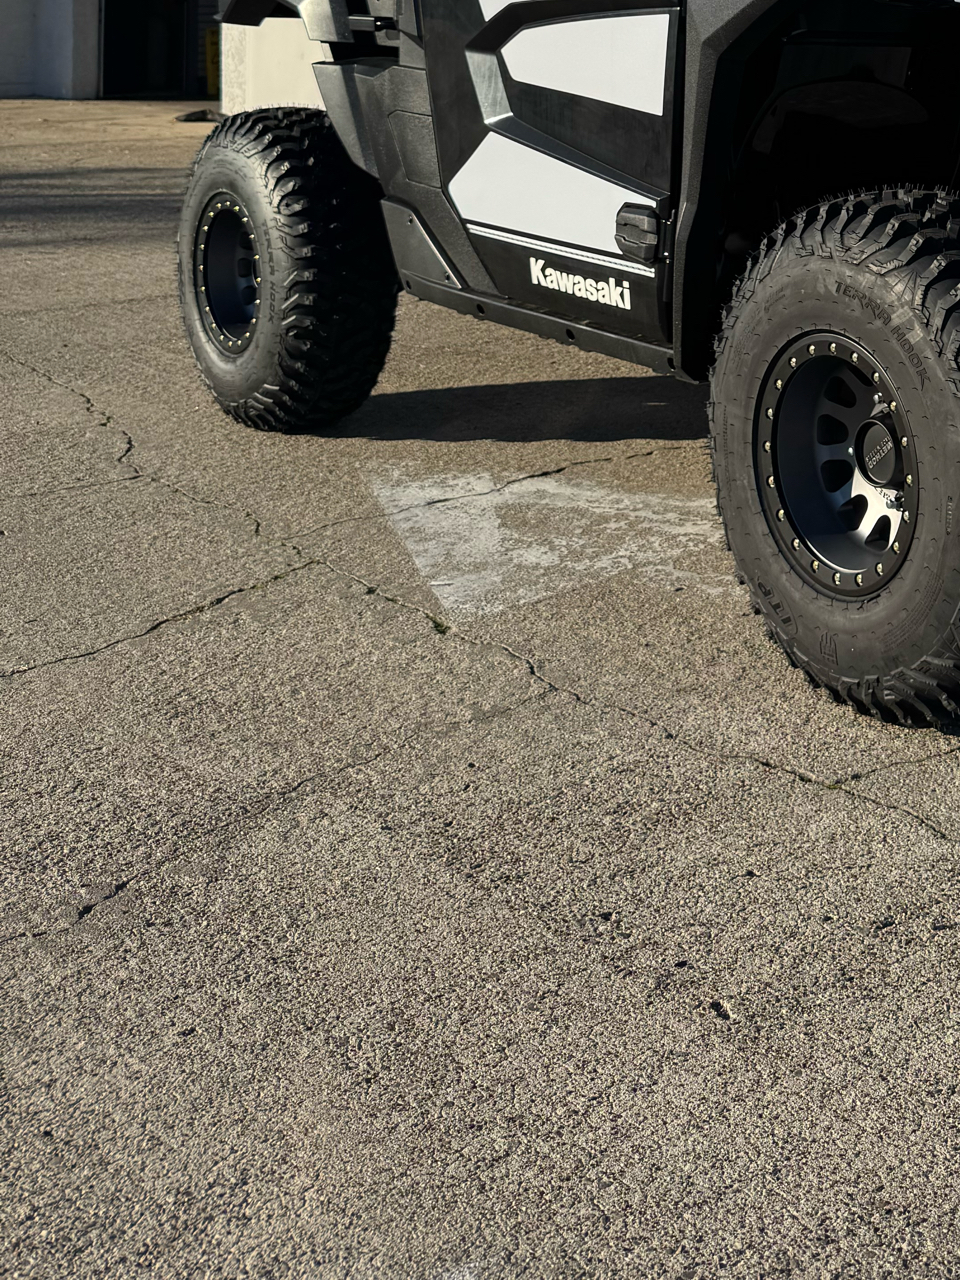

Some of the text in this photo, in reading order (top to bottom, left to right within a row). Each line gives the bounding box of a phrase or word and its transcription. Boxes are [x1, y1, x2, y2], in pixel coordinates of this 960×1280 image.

[529, 256, 631, 311] Kawasaki
[834, 280, 932, 392] TERRA HOOK
[868, 440, 893, 470] METHOD
[757, 580, 793, 628] ITP
